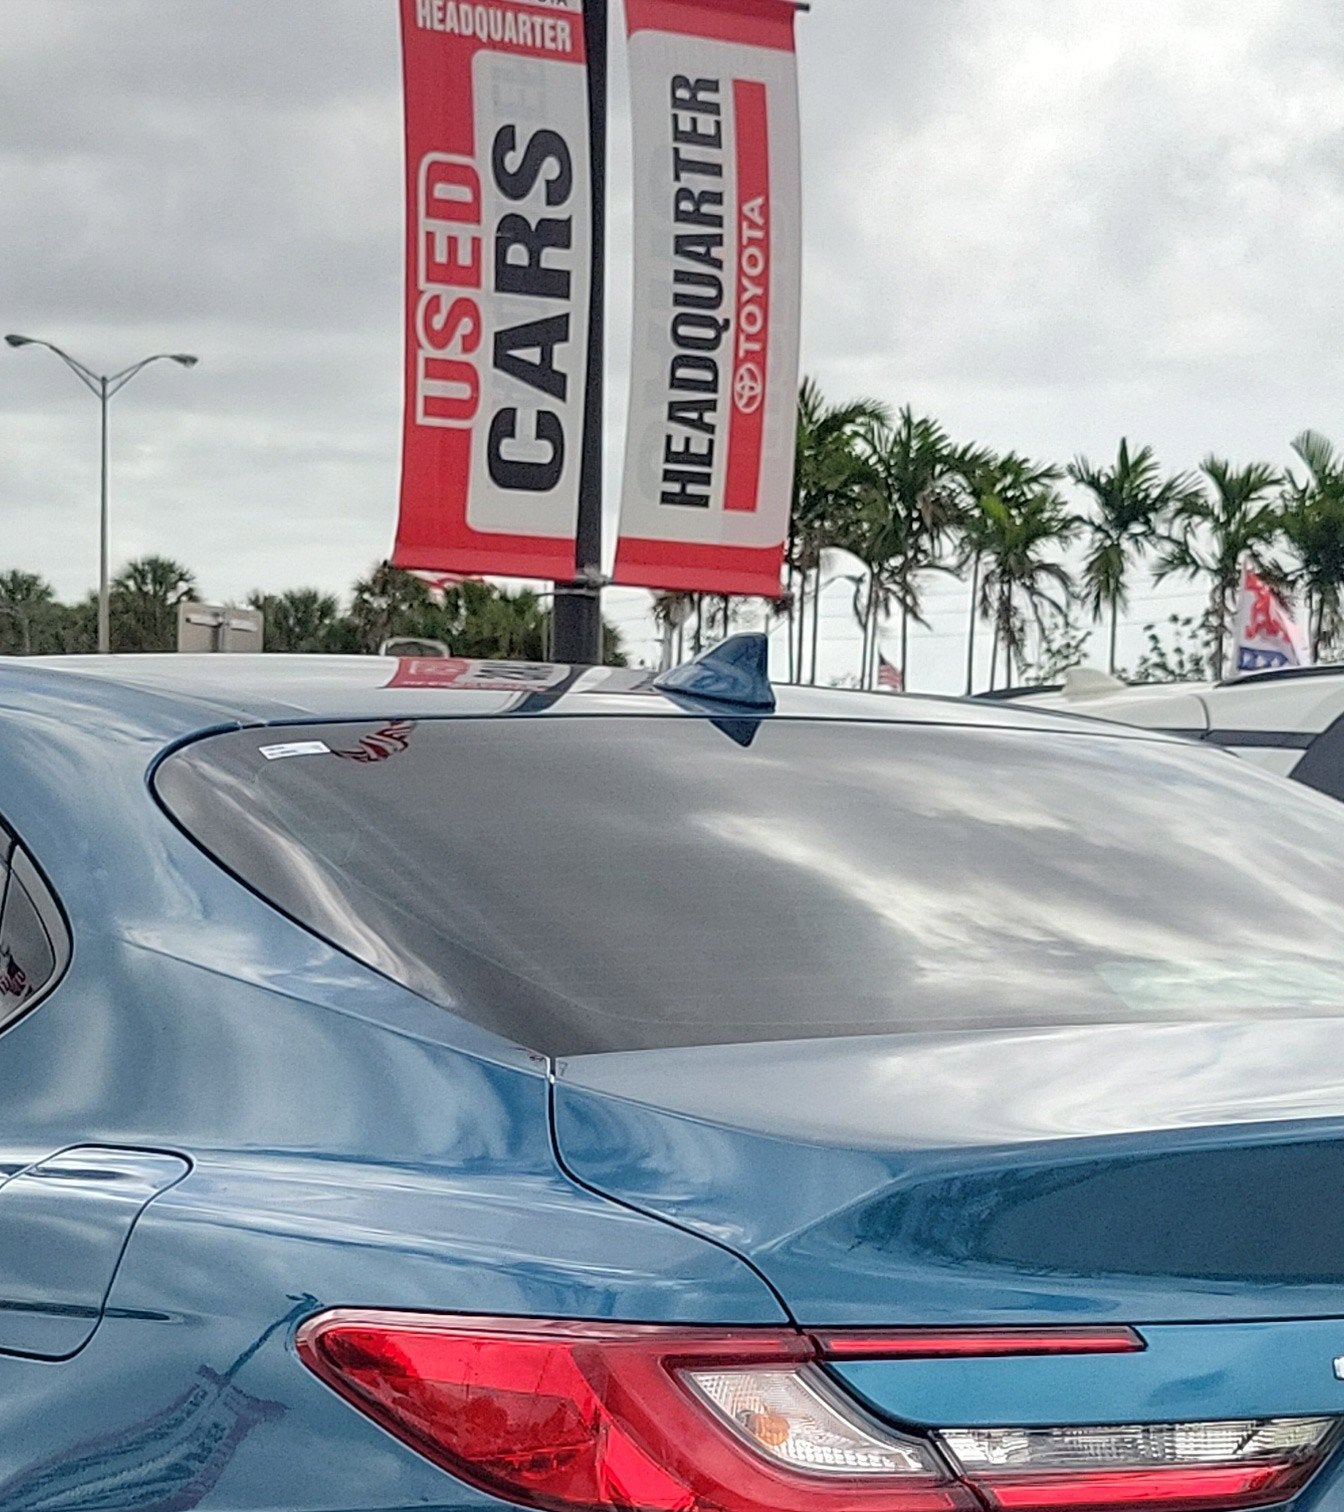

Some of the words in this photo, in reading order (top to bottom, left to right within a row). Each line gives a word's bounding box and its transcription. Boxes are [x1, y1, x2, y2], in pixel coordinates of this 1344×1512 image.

[416, 0, 572, 52] HEADQUARTER
[416, 152, 482, 428] USED
[487, 124, 573, 492] CARS
[659, 74, 731, 509] HEADQUARTER
[737, 196, 766, 358] TOYOTA
